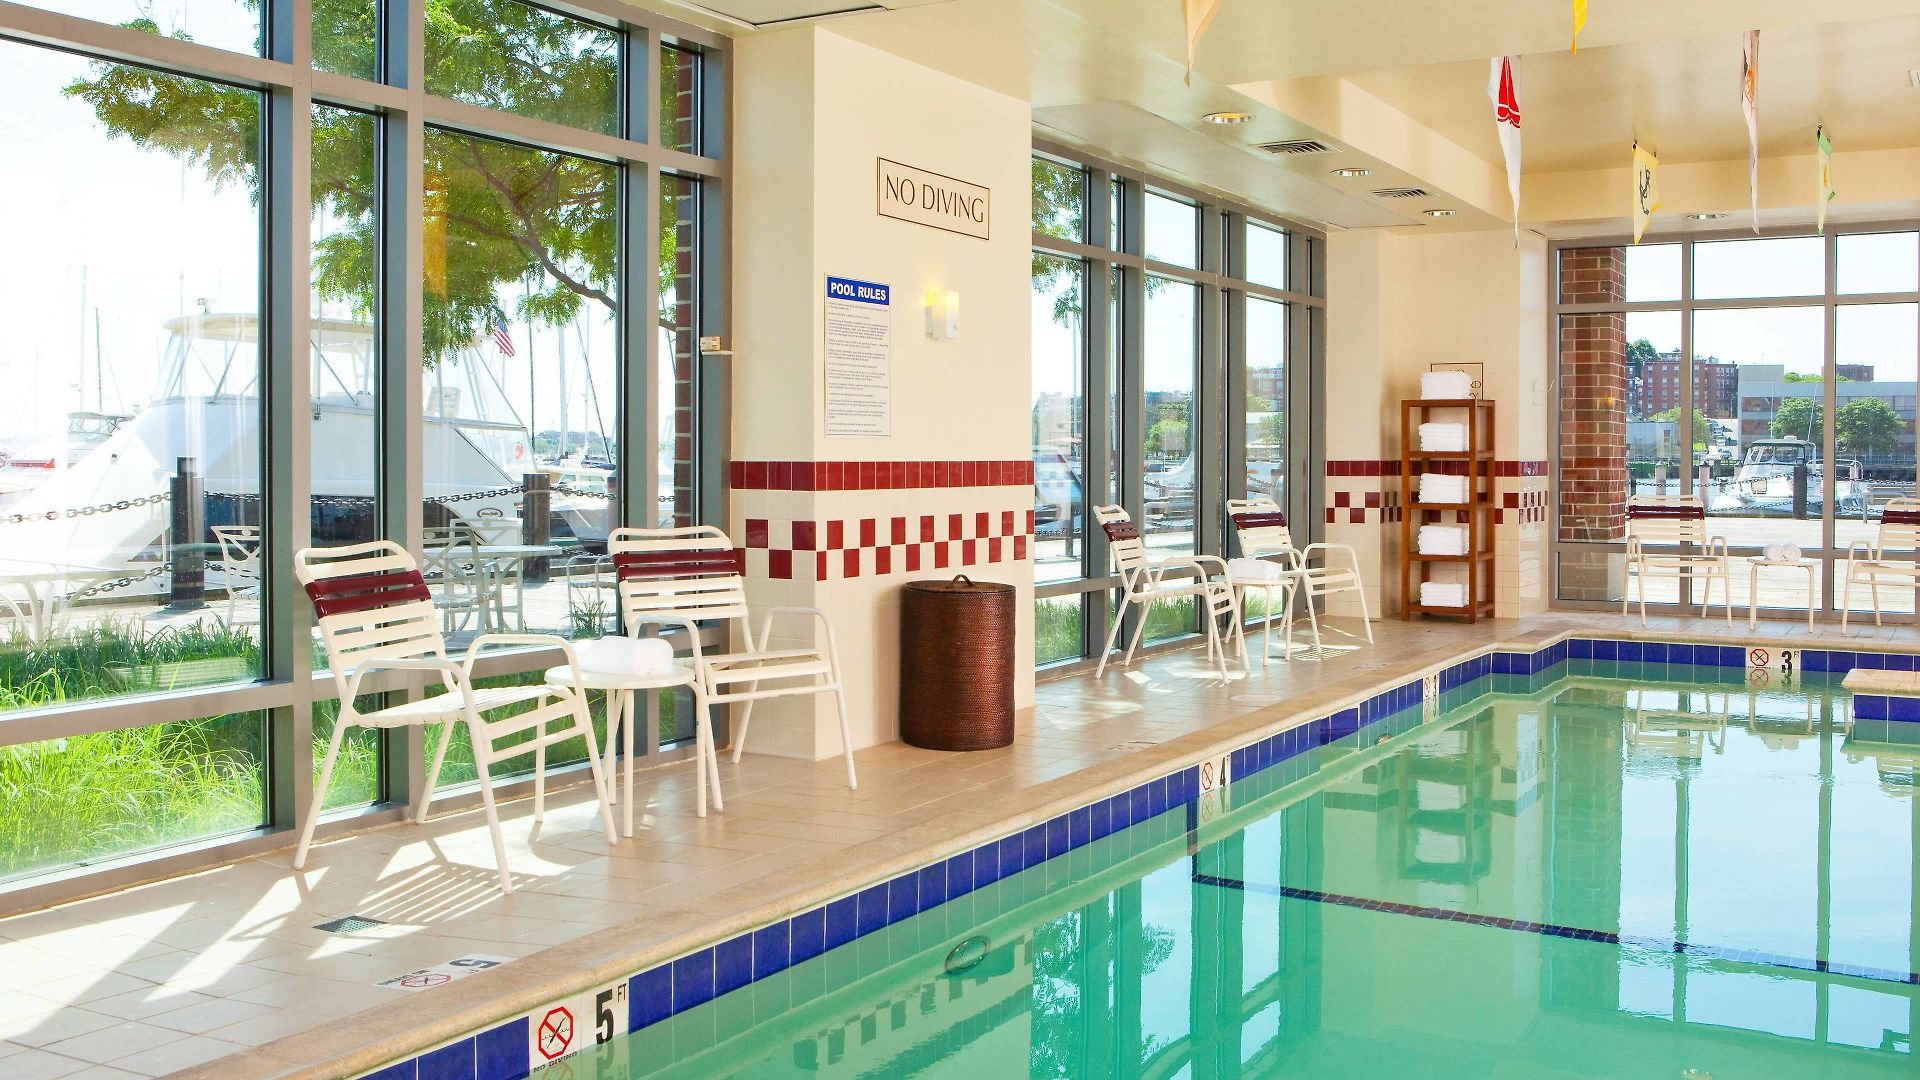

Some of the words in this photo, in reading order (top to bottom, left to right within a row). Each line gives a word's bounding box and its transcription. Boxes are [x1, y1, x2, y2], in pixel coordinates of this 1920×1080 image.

[886, 174, 915, 206] NO
[923, 183, 984, 223] DIVING
[830, 281, 856, 297] POOL
[858, 286, 887, 301] RULES
[1781, 650, 1793, 670] 3
[1219, 757, 1226, 786] 4
[596, 988, 615, 1045] 5
[617, 983, 627, 1003] FT
[533, 1064, 546, 1073] NO
[548, 1051, 578, 1067] DIVING
